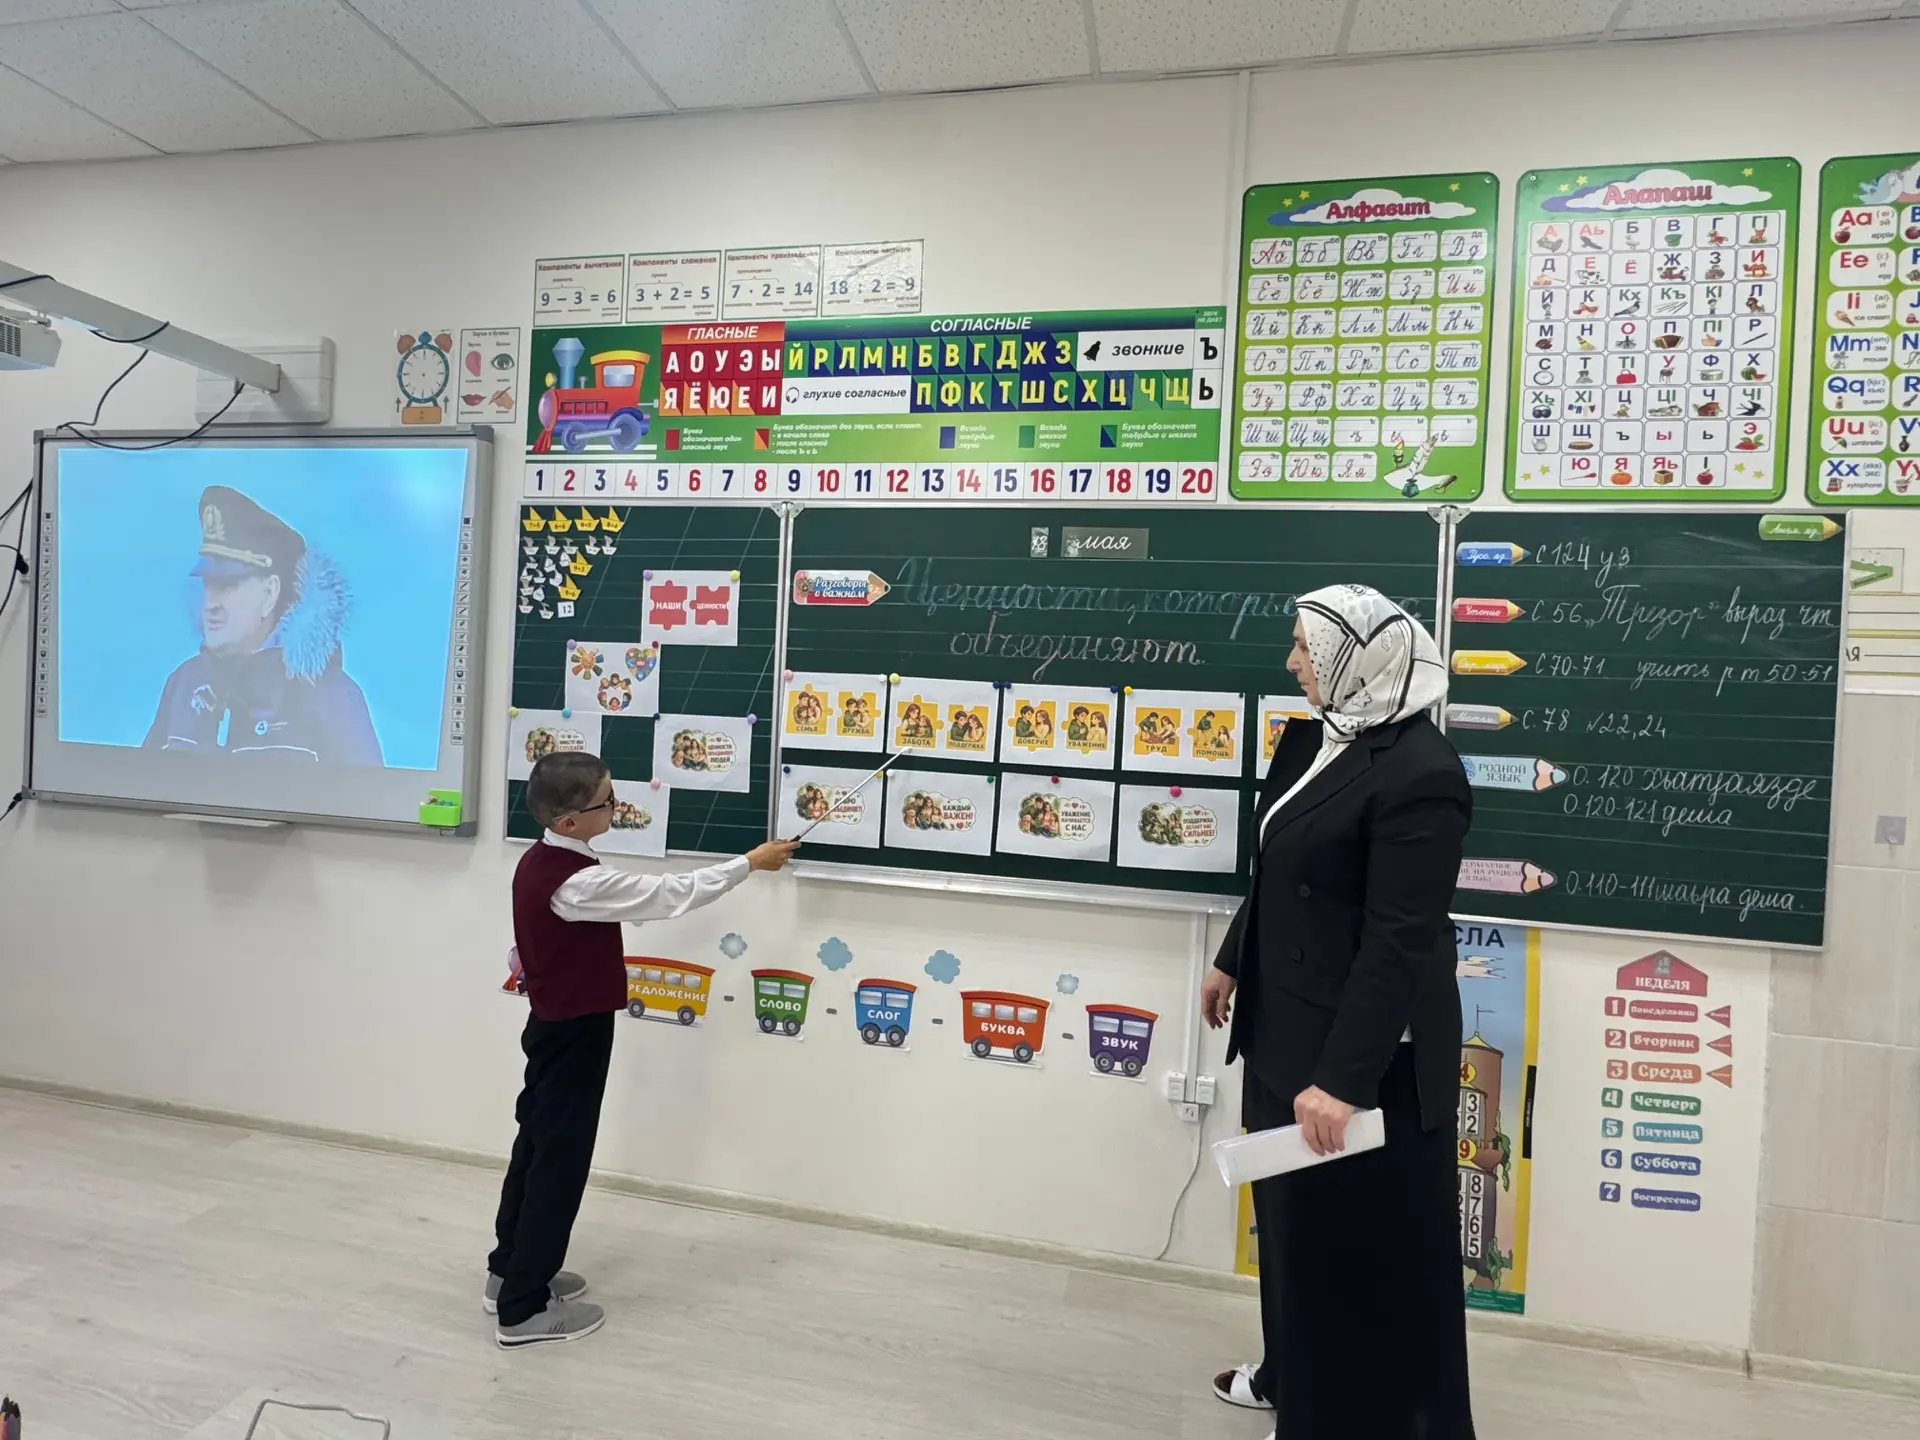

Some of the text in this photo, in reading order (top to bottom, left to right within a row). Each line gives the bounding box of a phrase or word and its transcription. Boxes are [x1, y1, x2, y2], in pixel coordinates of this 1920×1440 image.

[1602, 184, 1713, 205] Алапаш
[1326, 200, 1431, 223] Алфавит
[1838, 210, 1872, 226] Aa
[1840, 252, 1869, 268] Ee
[1847, 293, 1860, 309] Ii
[687, 326, 759, 340] ГЛАСНЫЕ
[930, 316, 1033, 333] СОГЛАСНЫЕ
[1112, 342, 1184, 357] звонкие
[1200, 337, 1218, 360] Ъ
[1830, 336, 1871, 351] Mm
[666, 349, 780, 373] А О У Э Ы
[803, 389, 906, 401] глухие согласные
[1199, 378, 1214, 400] Ь
[1828, 377, 1865, 396] Qq
[663, 382, 777, 409] Я Ё Ю Е И
[1829, 418, 1864, 435] Uu
[1826, 460, 1860, 476] Xx
[536, 468, 1213, 493] 1 2 3 4 5 6 7 8 9 10 11 12 13 14 15 16 17 18 19 20
[1076, 535, 1132, 550] мая
[1552, 543, 1590, 570] 124
[815, 577, 866, 590] Разговоры
[822, 589, 865, 598] важном
[562, 605, 572, 614] 12
[656, 602, 681, 610] НАШИ
[1142, 589, 1300, 640] которы
[1466, 605, 1500, 617] Чтение
[1553, 603, 1582, 623] 56
[1550, 656, 1605, 676] 70-71
[1630, 660, 1710, 690] учить
[1543, 708, 1570, 732] 78
[902, 738, 931, 746] ЗАБОТА
[1017, 738, 1049, 746] ДОВЕРИЕ
[1068, 741, 1105, 749] УВАЖЕНИЕ
[1146, 745, 1168, 753] ТРУД
[1479, 763, 1526, 774] РОДНОЙ
[1598, 764, 1633, 788] 120
[1486, 773, 1522, 783] ЯЗЫК
[943, 804, 971, 812] КАЖДЫЙ
[943, 812, 974, 820] ВАЖЕН!
[1585, 794, 1657, 823] 120-121
[1636, 977, 1690, 991] НЕДЕЛЯ
[628, 984, 707, 1002] РЕДЛОЖЕНИЕ
[759, 998, 802, 1012] СЛОВО
[1611, 1000, 1619, 1015] 1
[868, 1009, 900, 1021] СЛОГ
[981, 1022, 1025, 1037] БУКВА
[1101, 1037, 1139, 1051] ЗВУК
[1609, 1031, 1695, 1049] 2 Вторник
[1611, 1062, 1694, 1081] 3 Среда
[1468, 1094, 1478, 1112] 3
[1604, 1091, 1698, 1111] 4 Четверг
[1467, 1115, 1477, 1133] 2
[1605, 1122, 1700, 1140] 5 Пятница
[1460, 1140, 1470, 1158] 9
[1604, 1151, 1697, 1172] 6 Суббота
[1472, 1175, 1482, 1193] 8
[1604, 1184, 1698, 1206] 7 Воскресенье
[1471, 1197, 1480, 1214] 7
[1469, 1217, 1480, 1235] 6
[1469, 1238, 1480, 1256] 5
